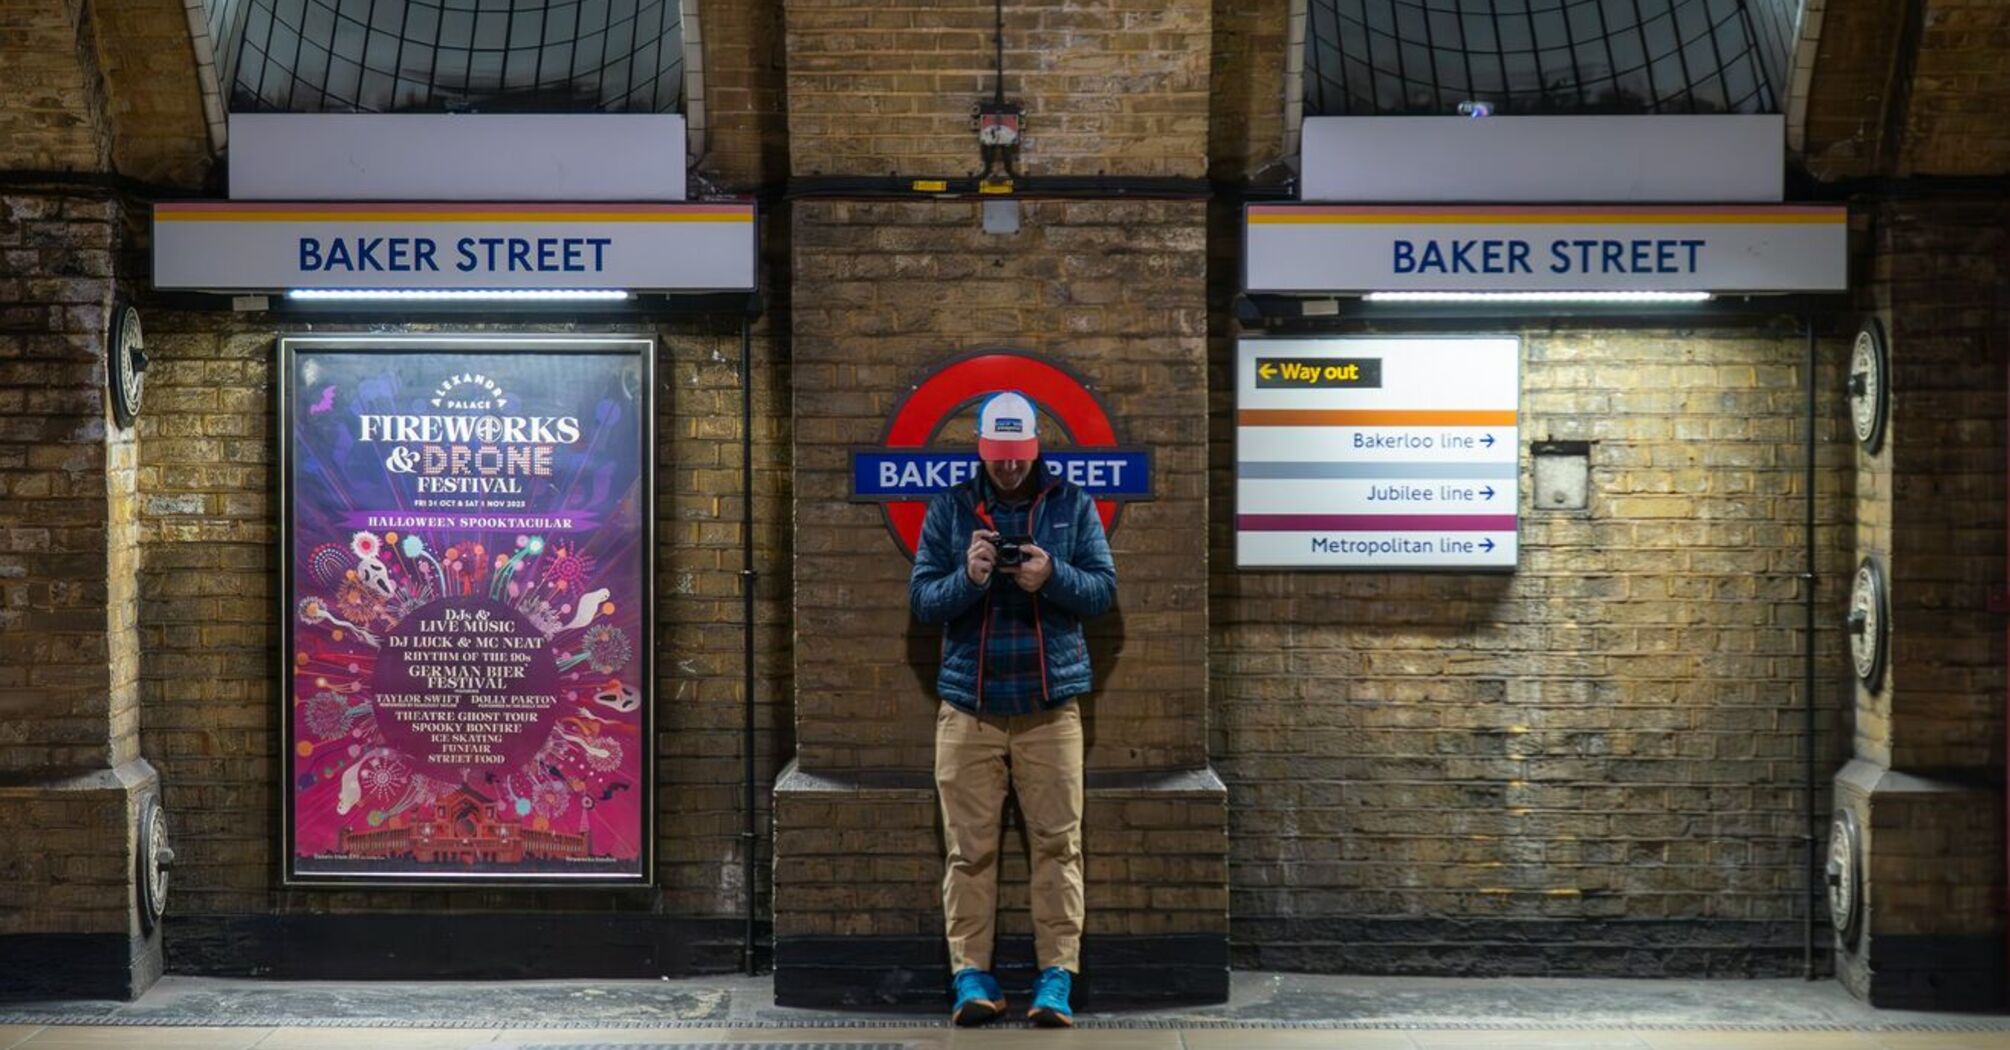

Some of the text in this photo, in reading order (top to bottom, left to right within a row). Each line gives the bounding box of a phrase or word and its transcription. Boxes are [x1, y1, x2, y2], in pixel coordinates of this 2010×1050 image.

[298, 236, 612, 273] BAKER STREET
[1392, 238, 1706, 274] BAKER STREET
[1280, 362, 1359, 384] Way out
[431, 372, 508, 410] ALEXANDRA
[448, 400, 490, 409] PALACE
[358, 415, 580, 444] FIREWORKS
[1353, 430, 1474, 450] Bakerloo line
[386, 445, 553, 476] & DRONE
[1045, 460, 1127, 487] EET
[418, 477, 521, 493] FESTIVAL
[1366, 484, 1474, 503] Jubilee line
[368, 517, 573, 529] HALLOWEEN SPOOKTACULAR
[1311, 536, 1474, 558] Metropolitan line
[445, 610, 490, 620] DJs &
[420, 621, 515, 633] LIVE MUSIC
[389, 637, 544, 648] DJ LUCK & MC NEAT
[404, 651, 459, 661] RHYTHM
[463, 651, 482, 661] OF
[485, 652, 507, 662] THE
[409, 665, 482, 678] GERMAN
[428, 677, 506, 689] FESTIVAL
[376, 694, 557, 705] TAYLOR SWIFT DOLLY PARTON
[395, 711, 538, 722] THEATRE GHOST TOUR
[412, 722, 522, 733] SPOOKY BONFIRE
[431, 734, 502, 743] ICE SKATING
[442, 744, 491, 753] FUNFAIR
[428, 754, 505, 764] STREET FOOD
